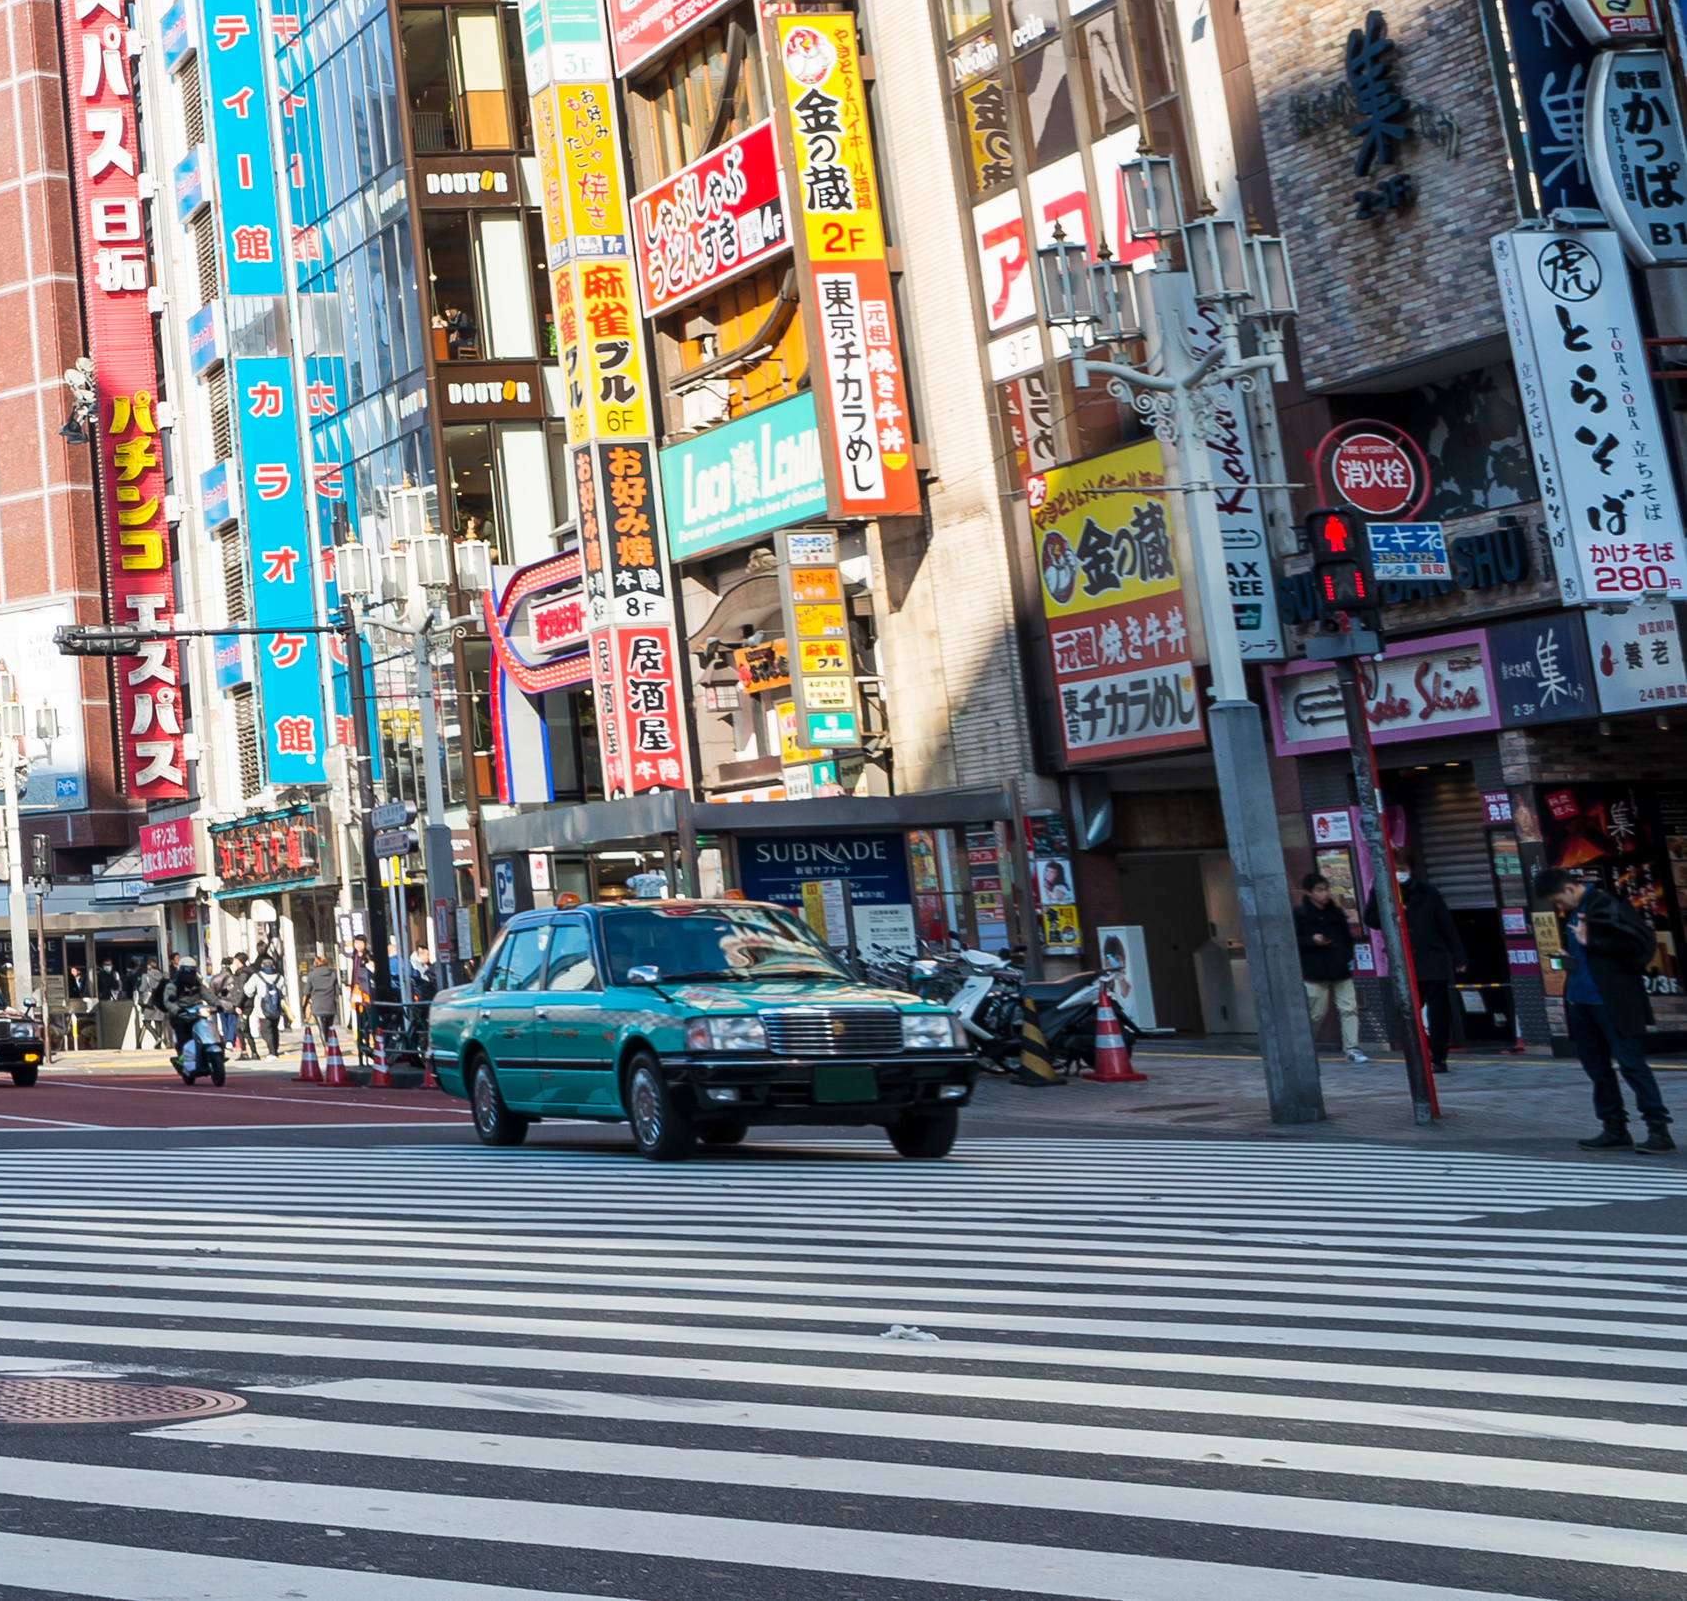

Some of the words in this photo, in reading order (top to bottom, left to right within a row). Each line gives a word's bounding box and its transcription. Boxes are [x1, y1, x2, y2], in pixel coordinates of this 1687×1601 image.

[1608, 16, 1651, 34] 2階
[1614, 70, 1662, 91] 新宿
[565, 96, 604, 163] もんじゃ
[581, 89, 609, 138] お好み
[565, 136, 590, 169] たこ
[794, 88, 854, 212] 金の蔵
[1622, 91, 1685, 210] かっぱ
[577, 171, 611, 230] 焼き
[640, 144, 748, 247] しゃぶしゃぶ
[647, 215, 739, 302] うどんすき
[1545, 240, 1597, 298] 虎
[582, 265, 637, 406] 麻雀ブル
[865, 302, 890, 345] 元祖
[1607, 326, 1629, 377] TORA
[820, 278, 876, 493] 東京チカラめし
[867, 348, 907, 454] 焼き牛丼
[1620, 380, 1642, 432] SOBA
[1555, 304, 1635, 537] とらそば
[111, 395, 164, 572] パチンコ
[1340, 458, 1408, 490] 消火栓
[1630, 440, 1663, 522] 立ちそば
[607, 446, 655, 568] お好み焼
[247, 382, 316, 755] カラオケ館
[614, 567, 661, 592] 本陣
[1075, 500, 1175, 599] 金の蔵
[1420, 563, 1445, 577] 買取
[1589, 541, 1676, 566] かけそば
[1594, 565, 1683, 593] 280円
[804, 643, 841, 657] 麻雀
[1054, 626, 1097, 673] 元祖
[1098, 605, 1187, 667] 焼き牛丼
[1536, 628, 1568, 709] 集
[1623, 638, 1670, 670] 養老
[627, 639, 676, 753] 居酒屋
[1062, 688, 1081, 743] 東京
[1080, 672, 1195, 742] チカラめし
[633, 759, 682, 782] 本陣
[756, 840, 887, 864] SUBNADE
